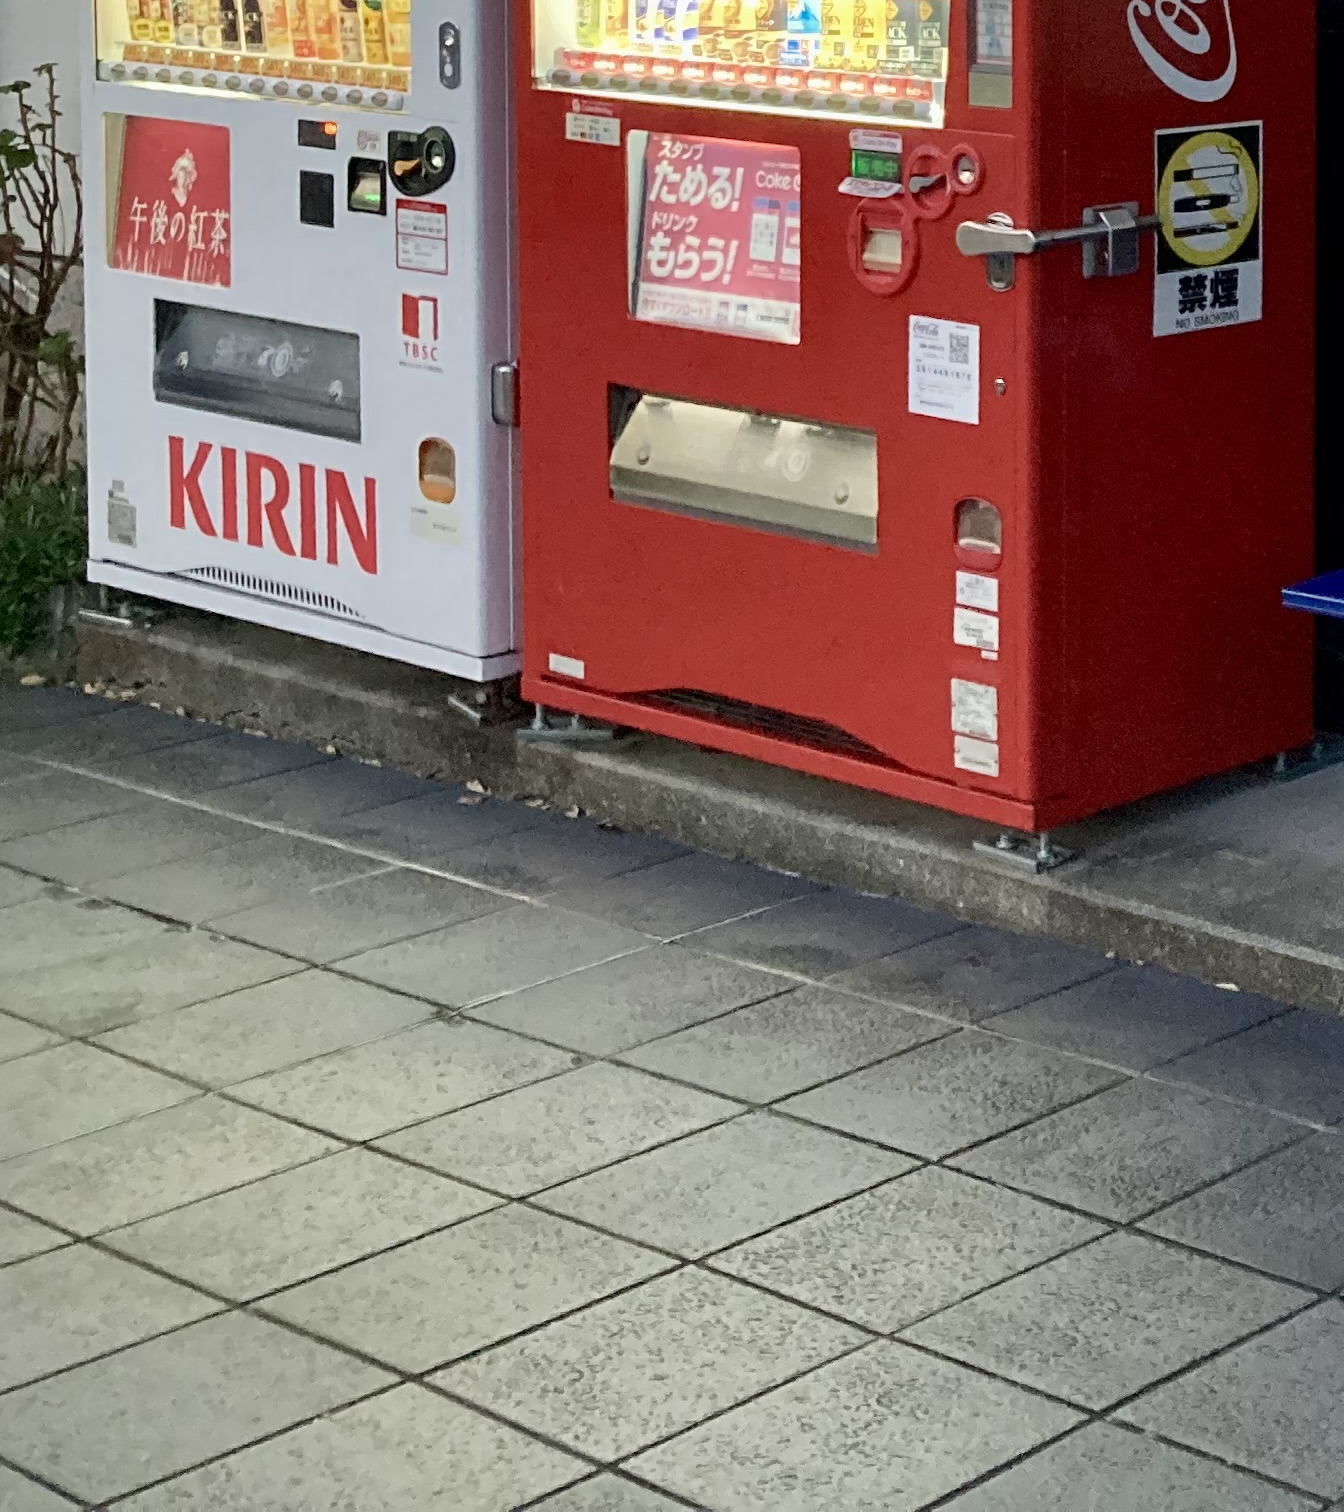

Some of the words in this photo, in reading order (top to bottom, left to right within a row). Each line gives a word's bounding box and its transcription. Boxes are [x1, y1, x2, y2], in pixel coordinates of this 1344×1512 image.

[657, 140, 705, 161] スタンプ
[649, 160, 744, 213] ためる!
[755, 169, 791, 190] Coke
[127, 196, 231, 258] 午後の紅茶
[651, 210, 699, 233] ドリンク
[647, 231, 740, 286] もらう!
[1178, 268, 1240, 315] 禁煙
[1175, 317, 1191, 329] NO
[1194, 309, 1240, 328] SMOKING
[403, 341, 438, 362] TBSC
[168, 434, 378, 575] KIRIN
